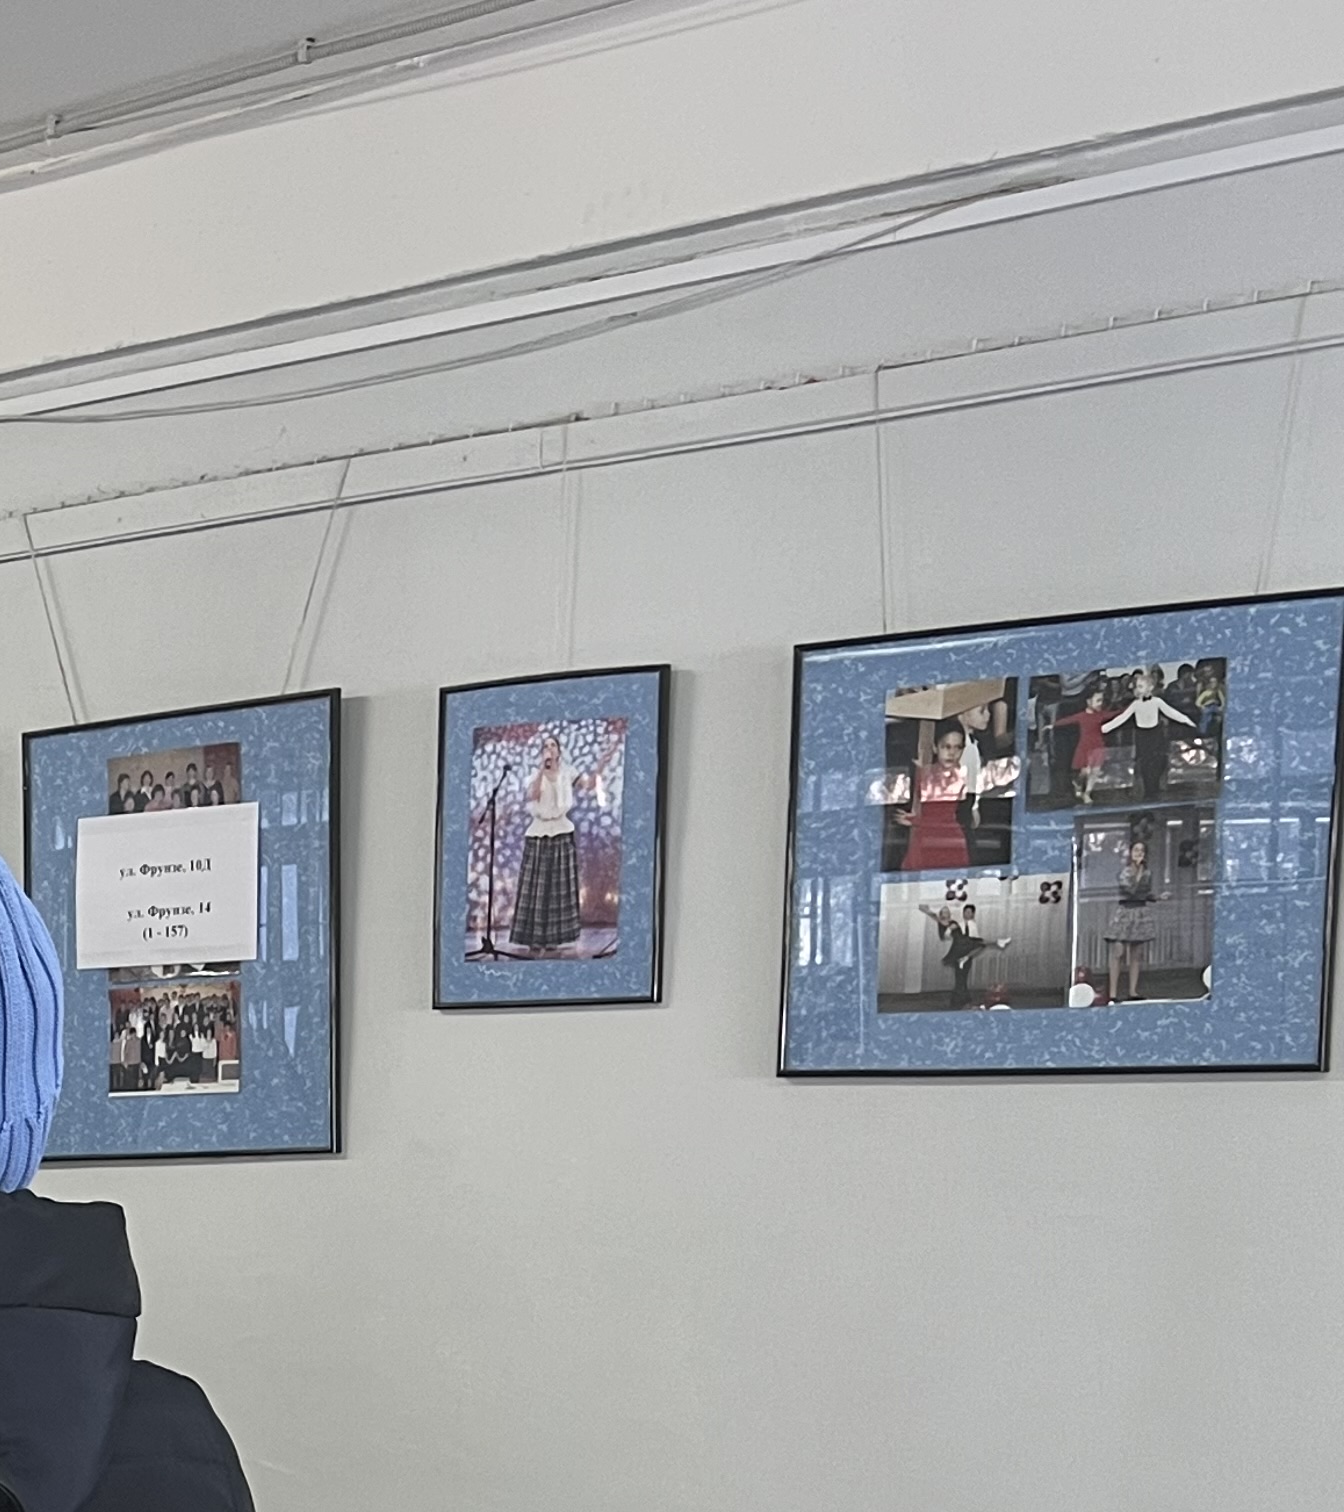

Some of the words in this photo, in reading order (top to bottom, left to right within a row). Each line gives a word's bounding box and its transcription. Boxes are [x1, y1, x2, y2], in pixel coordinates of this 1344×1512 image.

[119, 867, 136, 880] ул.
[139, 862, 186, 878] Фрунзе,
[127, 909, 144, 922] ул.
[147, 905, 194, 920] Фрунзе,
[198, 902, 211, 914] 14
[142, 926, 153, 941] (1
[165, 925, 189, 939] 157)
